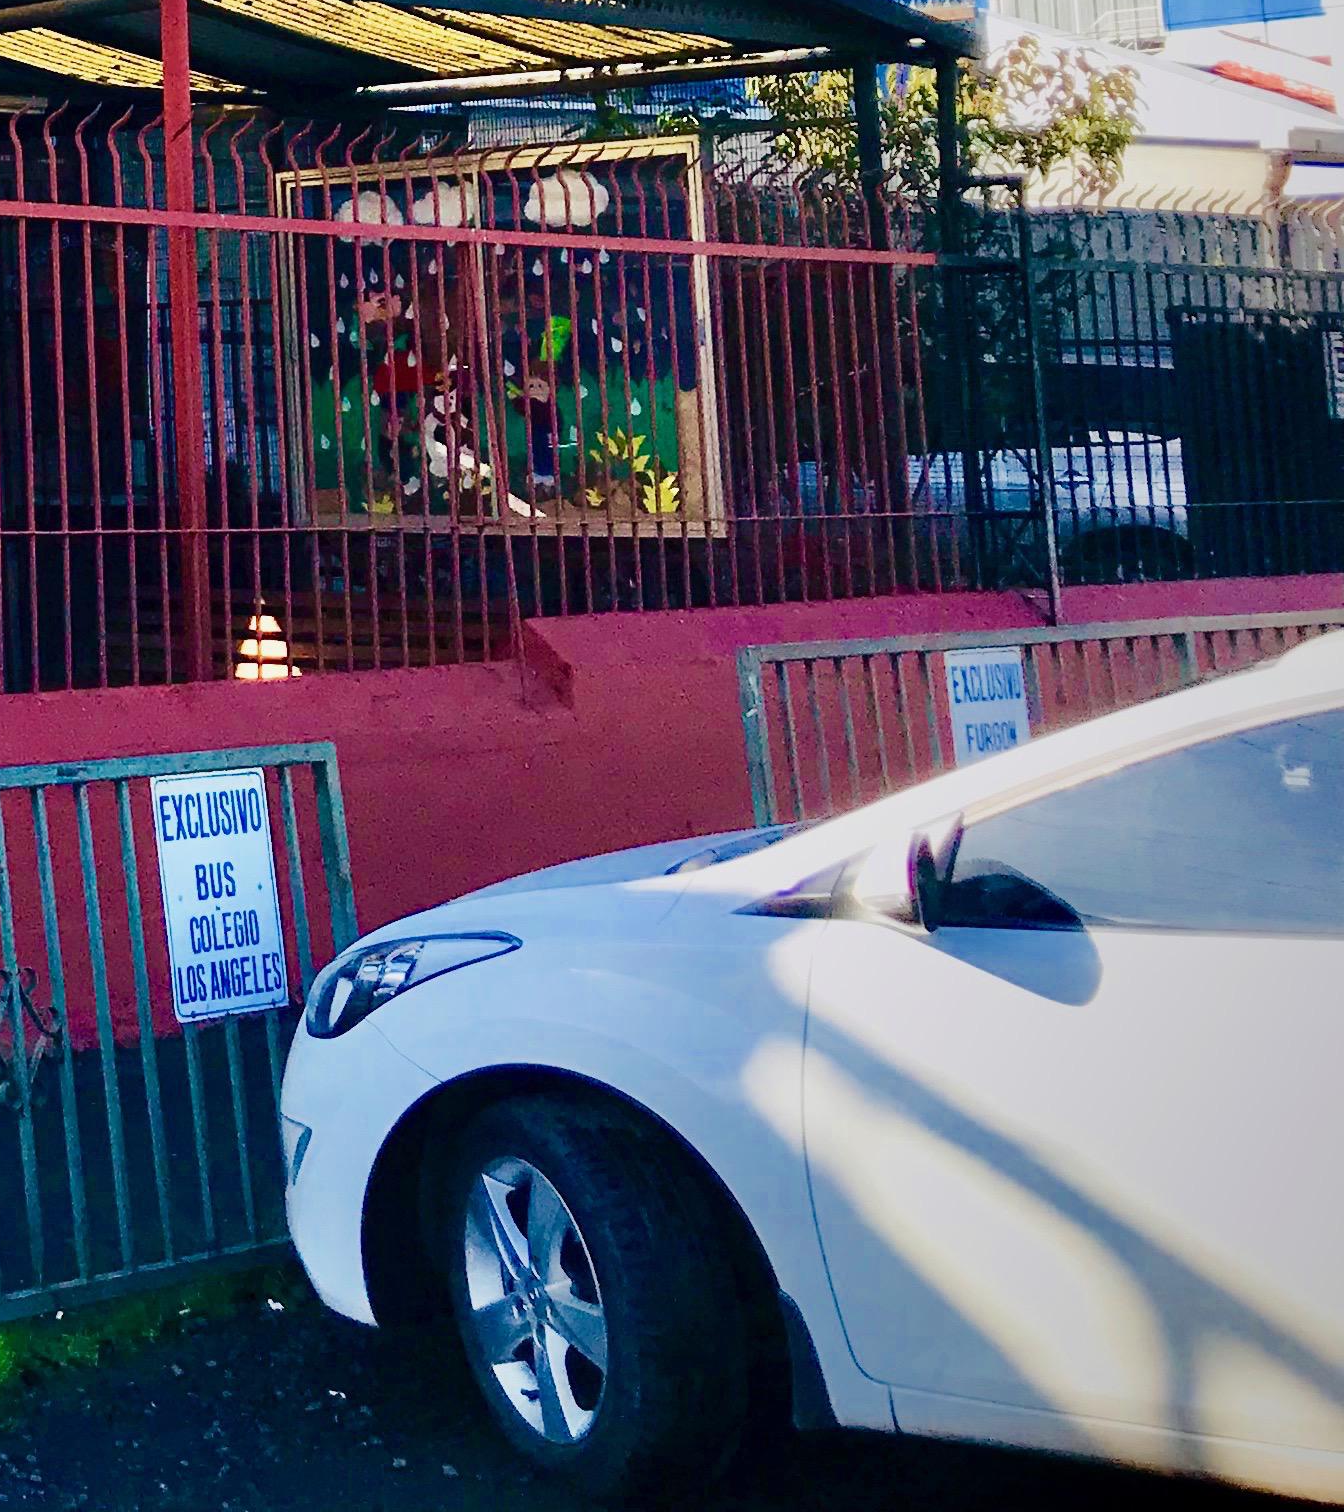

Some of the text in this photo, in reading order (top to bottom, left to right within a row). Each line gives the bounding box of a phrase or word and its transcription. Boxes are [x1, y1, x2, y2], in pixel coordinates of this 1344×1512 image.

[951, 663, 1021, 703] EXCLUSIVO
[159, 787, 263, 842] EXCLUSIVO
[194, 860, 237, 901] BUS
[177, 951, 283, 1005] LOS ANGELES
